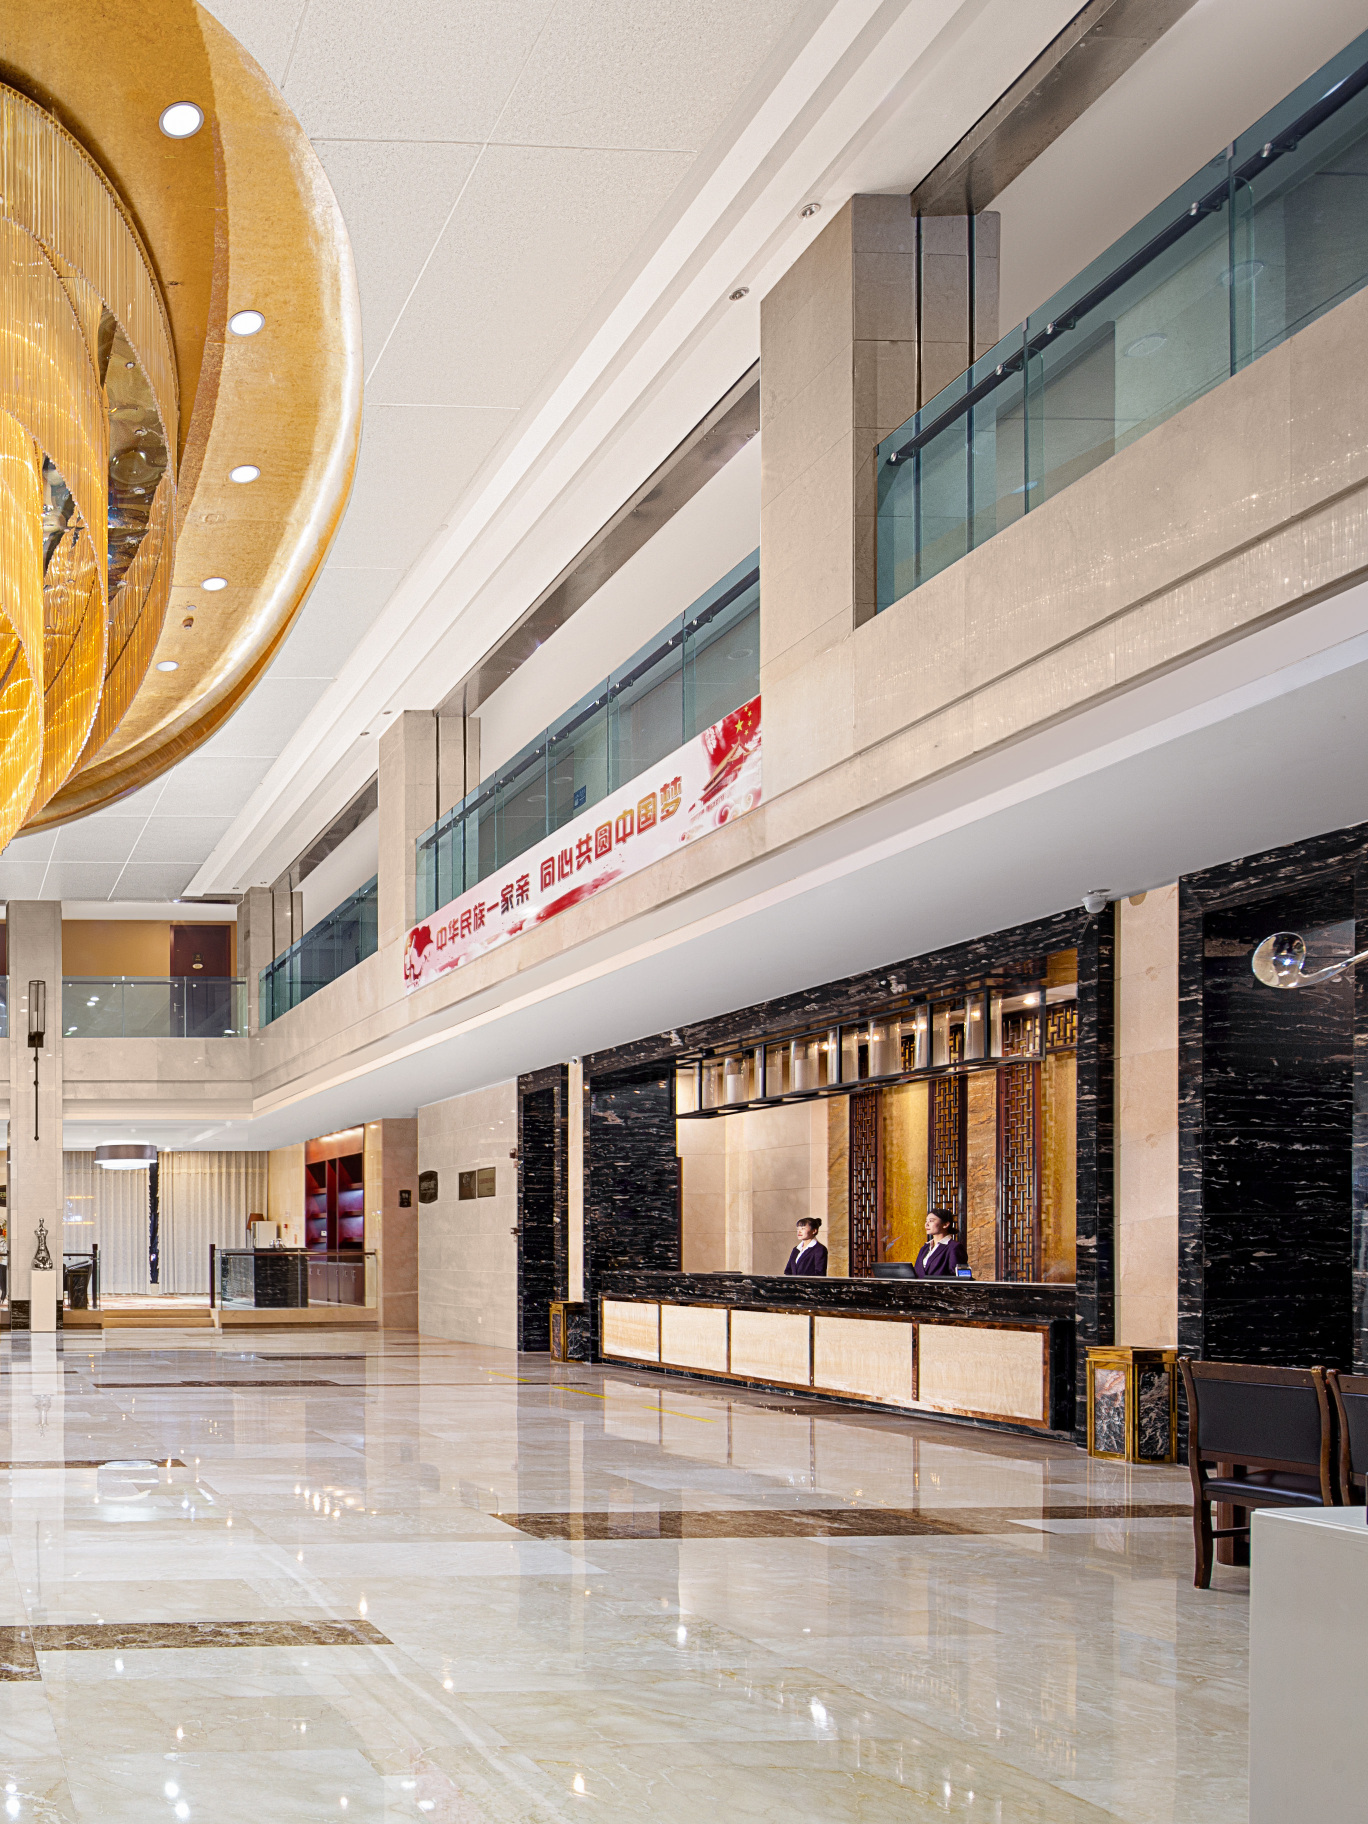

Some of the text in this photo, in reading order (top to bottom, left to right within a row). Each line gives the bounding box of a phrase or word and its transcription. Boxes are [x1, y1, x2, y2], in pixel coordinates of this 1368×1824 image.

[436, 776, 682, 951] 中华民族一家亲 同心共圆中国梦
